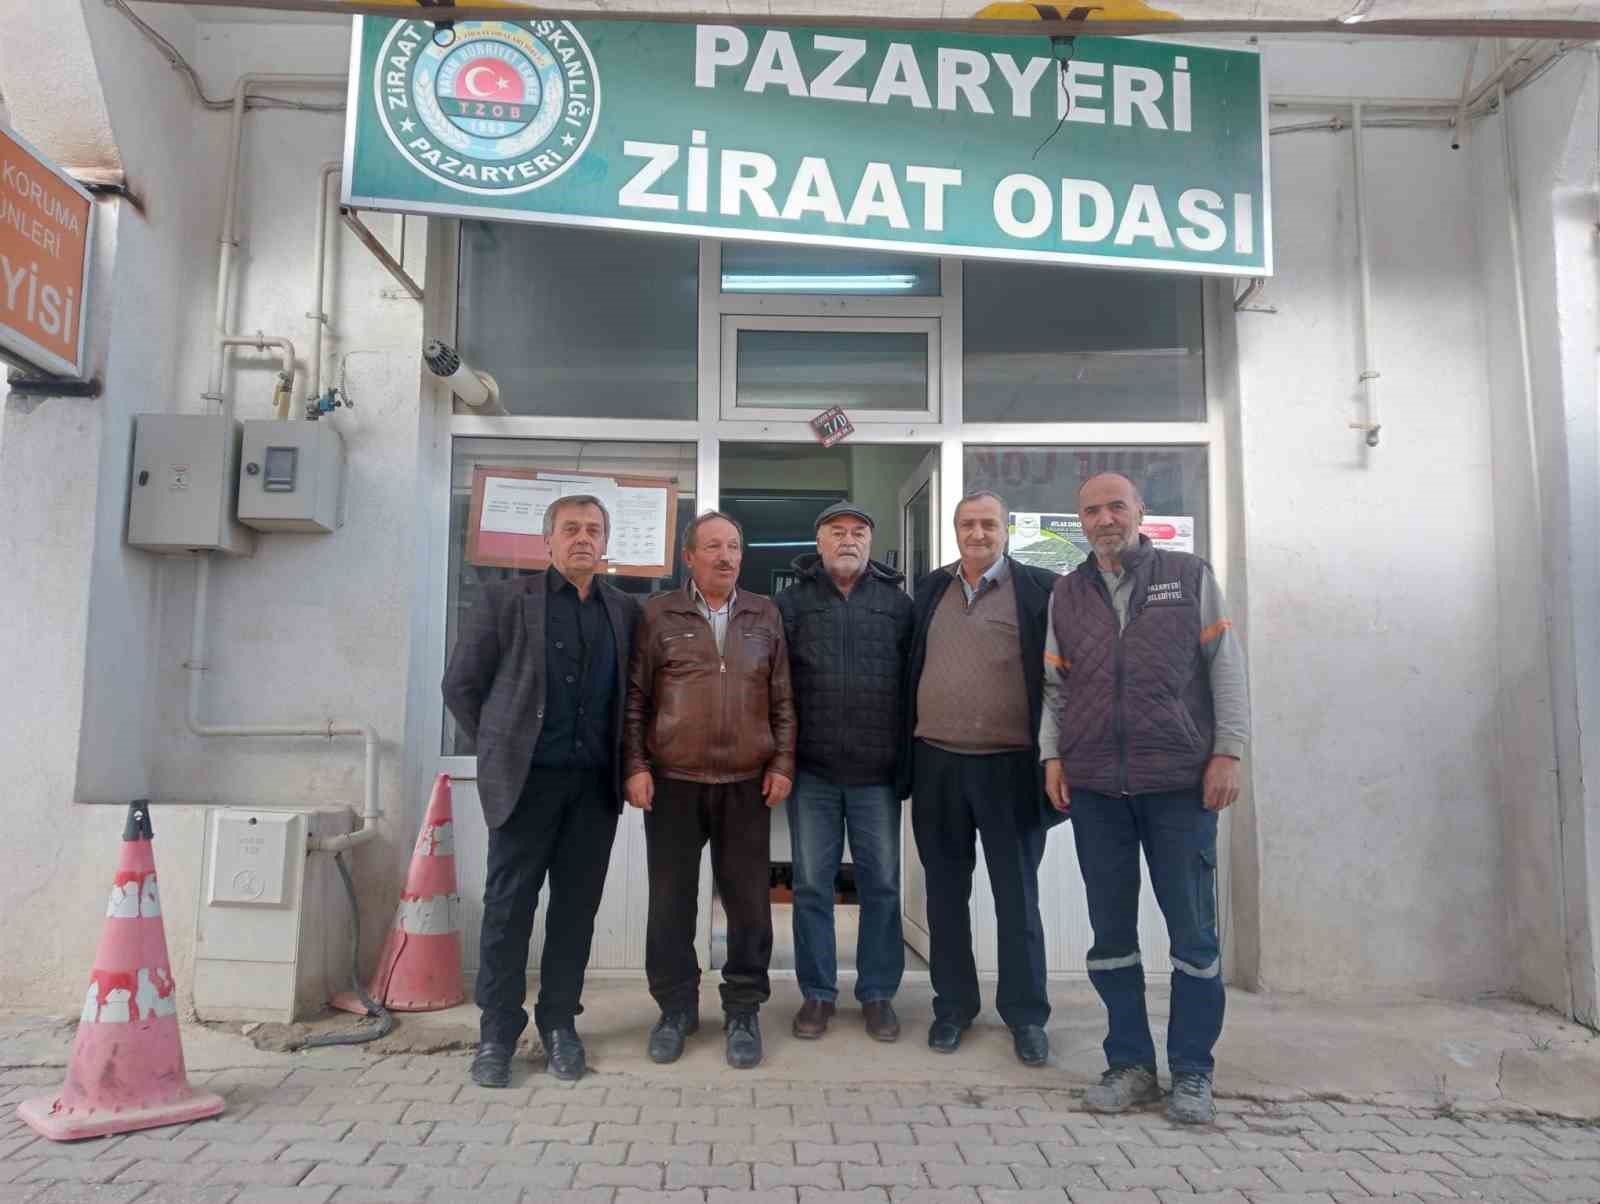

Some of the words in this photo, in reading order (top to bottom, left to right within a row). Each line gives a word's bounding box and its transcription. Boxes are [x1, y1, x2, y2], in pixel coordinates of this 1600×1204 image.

[387, 24, 422, 110] ZİRAAT
[530, 20, 590, 127] ŞKANLIĞI
[694, 25, 1192, 132] PAZARYERİ
[3, 159, 80, 237] KORUMA
[409, 136, 562, 182] PAZARYERİ
[618, 129, 962, 232] ZİRAAT
[992, 172, 1253, 254] ODASI
